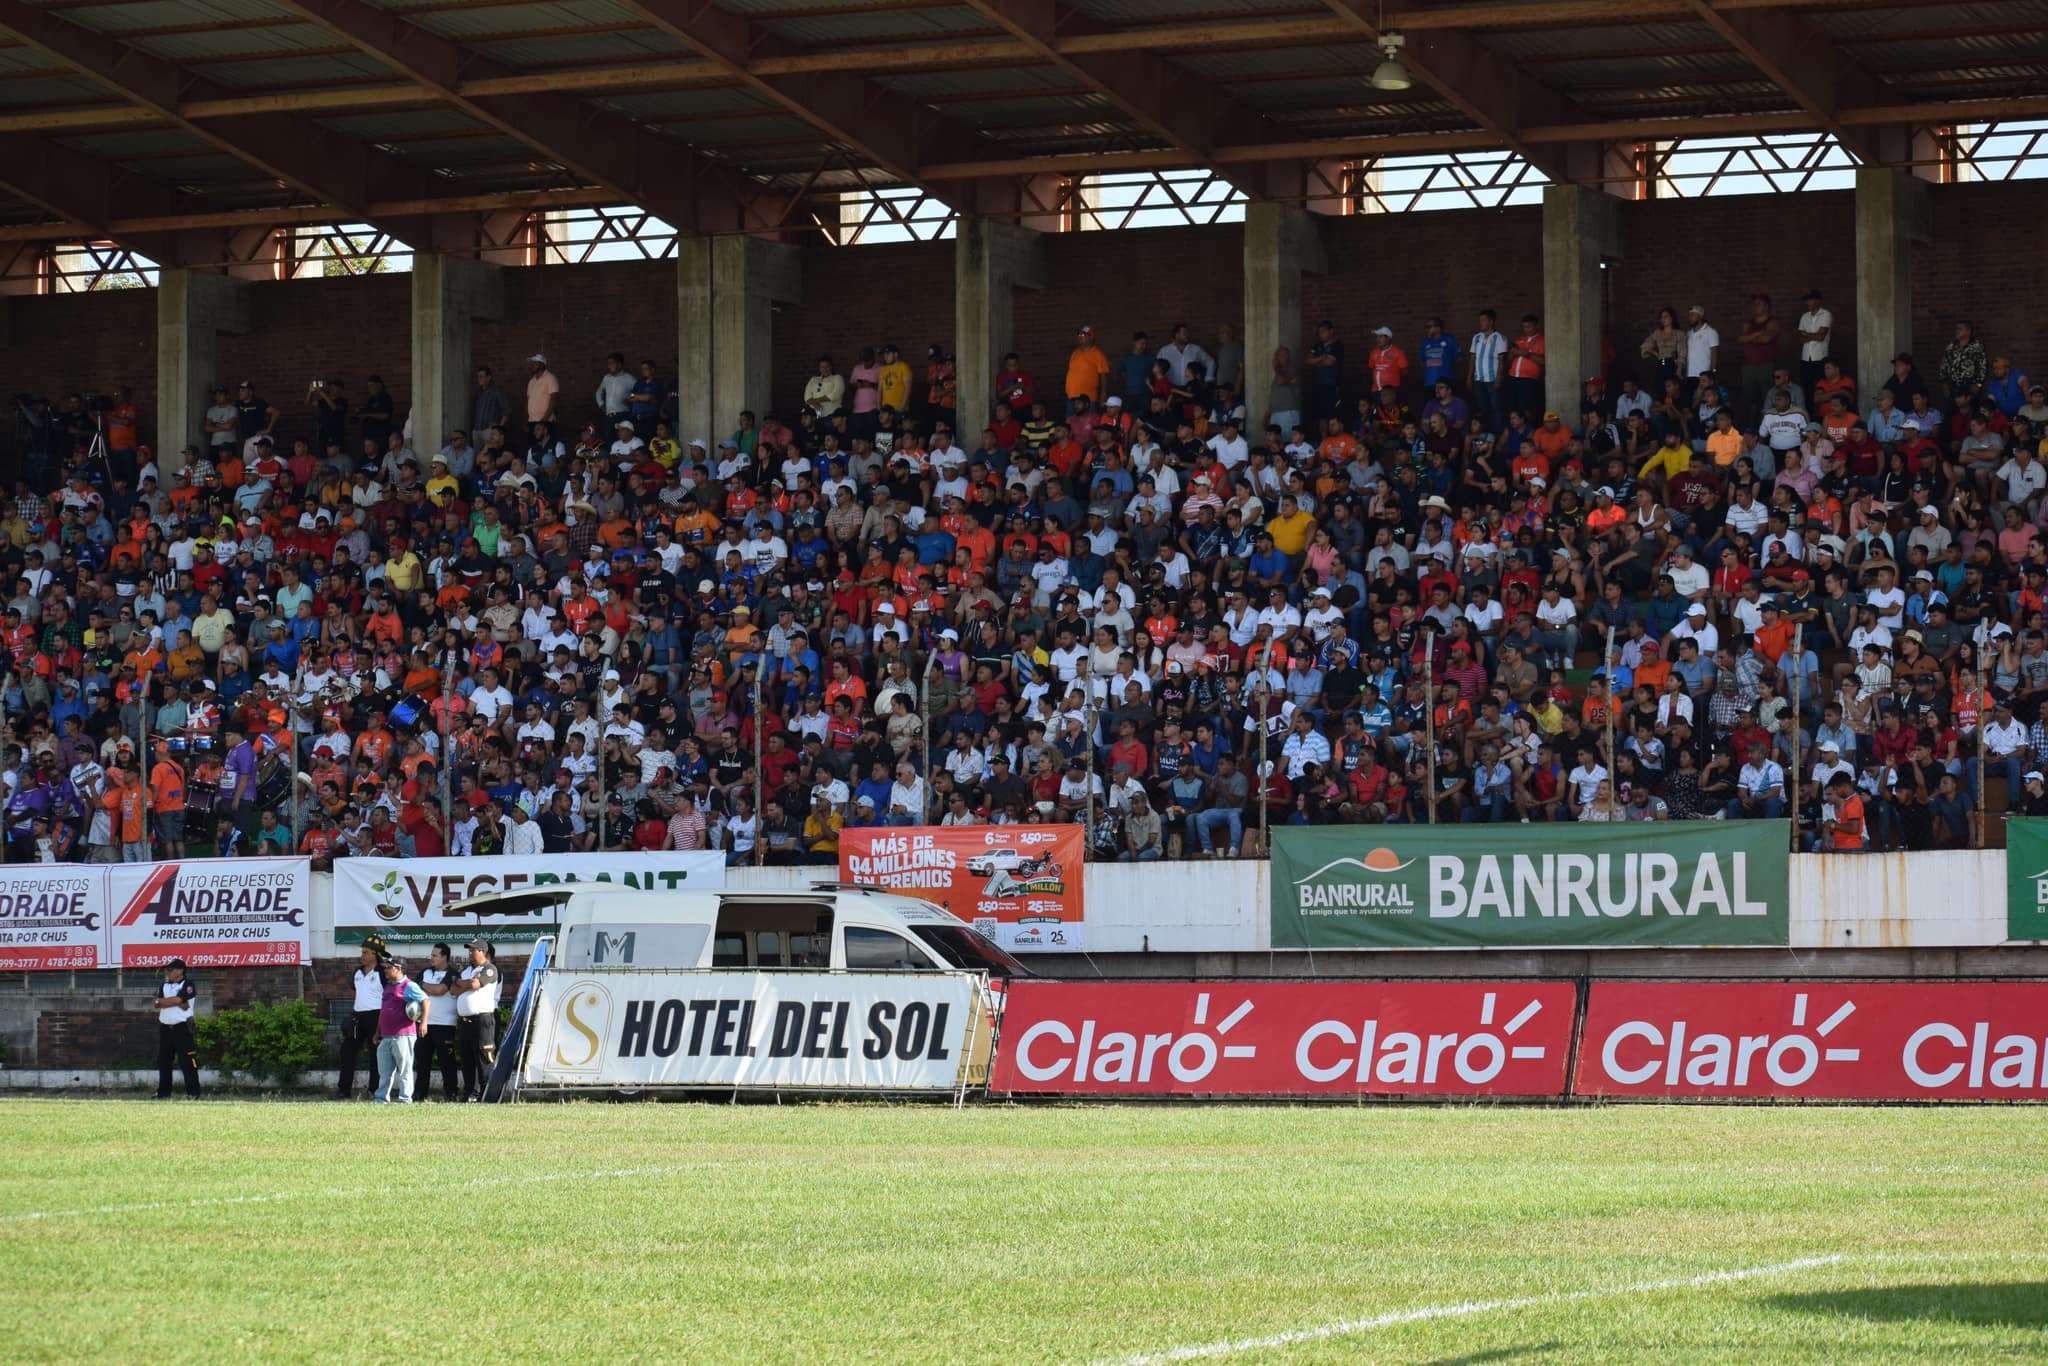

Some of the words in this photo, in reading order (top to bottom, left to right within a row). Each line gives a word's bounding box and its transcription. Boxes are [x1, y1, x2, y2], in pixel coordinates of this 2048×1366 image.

[871, 833, 907, 856] MÁS
[913, 835, 934, 850] DE
[985, 832, 994, 845] 6
[873, 848, 956, 875] MILLONES
[10, 879, 90, 893] REPUESTOS
[210, 873, 294, 888] REPUESTOS
[880, 870, 952, 888] PREMIOS
[1428, 851, 1768, 919] BANRURAL
[1300, 883, 1414, 907] BANRURAL
[1309, 908, 1332, 917] amigo
[1334, 908, 1348, 917] que
[1359, 907, 1381, 917] ayuda
[16, 932, 38, 943] POR
[40, 931, 68, 942] CHUS
[160, 928, 215, 940] PREGUNTA
[218, 928, 239, 938] POR
[242, 927, 270, 938] CHUS
[192, 954, 240, 965] 5999-3777
[248, 953, 296, 964] 4787-0839
[618, 999, 757, 1059] HOTEL
[768, 1000, 850, 1060] DEL
[862, 1001, 950, 1061] SOL
[1015, 1019, 1218, 1084] Claro
[1295, 1019, 1506, 1085] Claro
[1602, 1020, 1819, 1087] Claro
[1902, 1022, 2048, 1088] Cla
